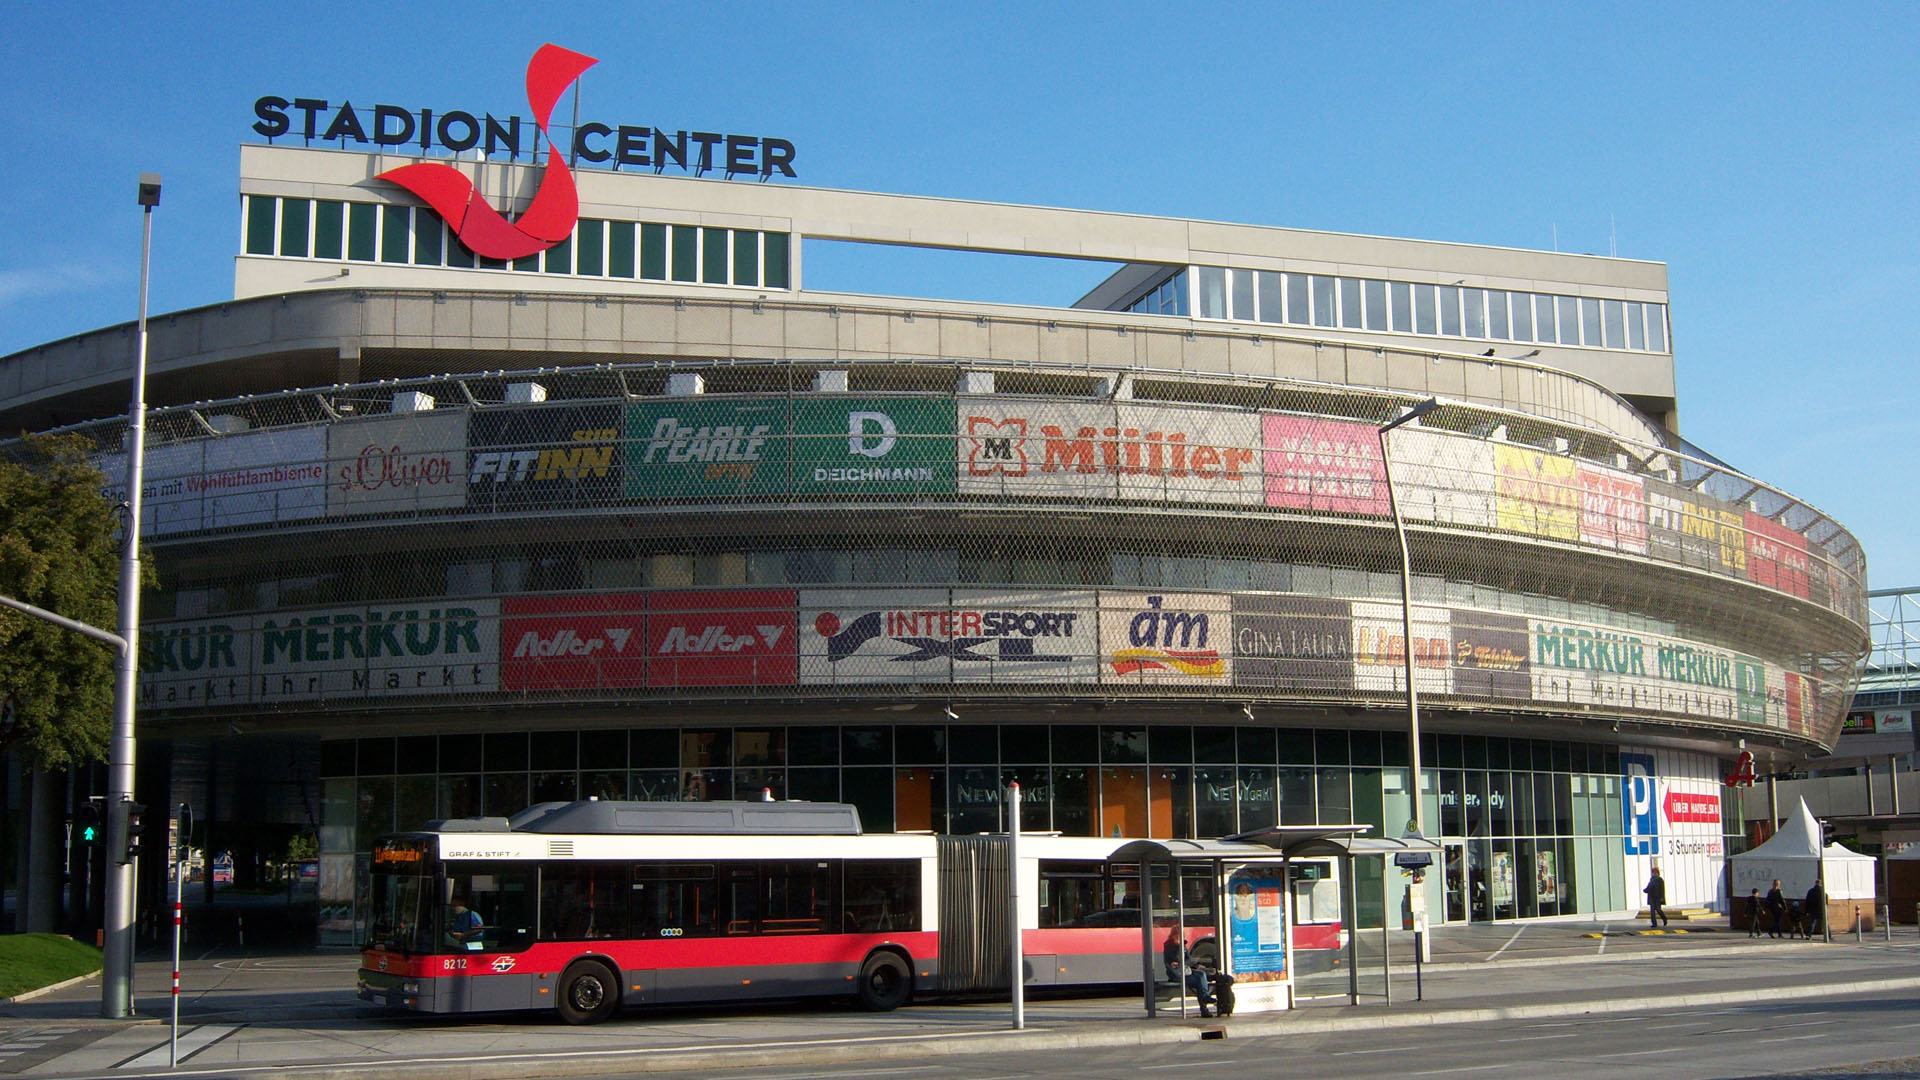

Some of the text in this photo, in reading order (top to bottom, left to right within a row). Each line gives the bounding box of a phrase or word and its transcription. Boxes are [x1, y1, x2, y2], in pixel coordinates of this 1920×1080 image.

[252, 96, 798, 179] STADION CENTER
[643, 417, 771, 463] PEARLE
[850, 410, 898, 458] D
[984, 436, 1012, 459] M
[1041, 426, 1254, 481] Müller
[101, 464, 322, 502] Shoen mit Wohlfühlambiente
[814, 467, 933, 481] DEICHMANN
[262, 606, 482, 665] MERKUR
[513, 629, 604, 657] Adler
[659, 627, 755, 654] Adler
[888, 610, 1076, 639] INTERSPORT
[1129, 596, 1208, 648] dm
[152, 624, 236, 673] KUR
[1536, 623, 1646, 677] MERKUR
[1657, 640, 1731, 689] MERKUR
[262, 663, 483, 697] Ihr Markt
[1627, 763, 1650, 848] P
[443, 959, 467, 969] 8212
